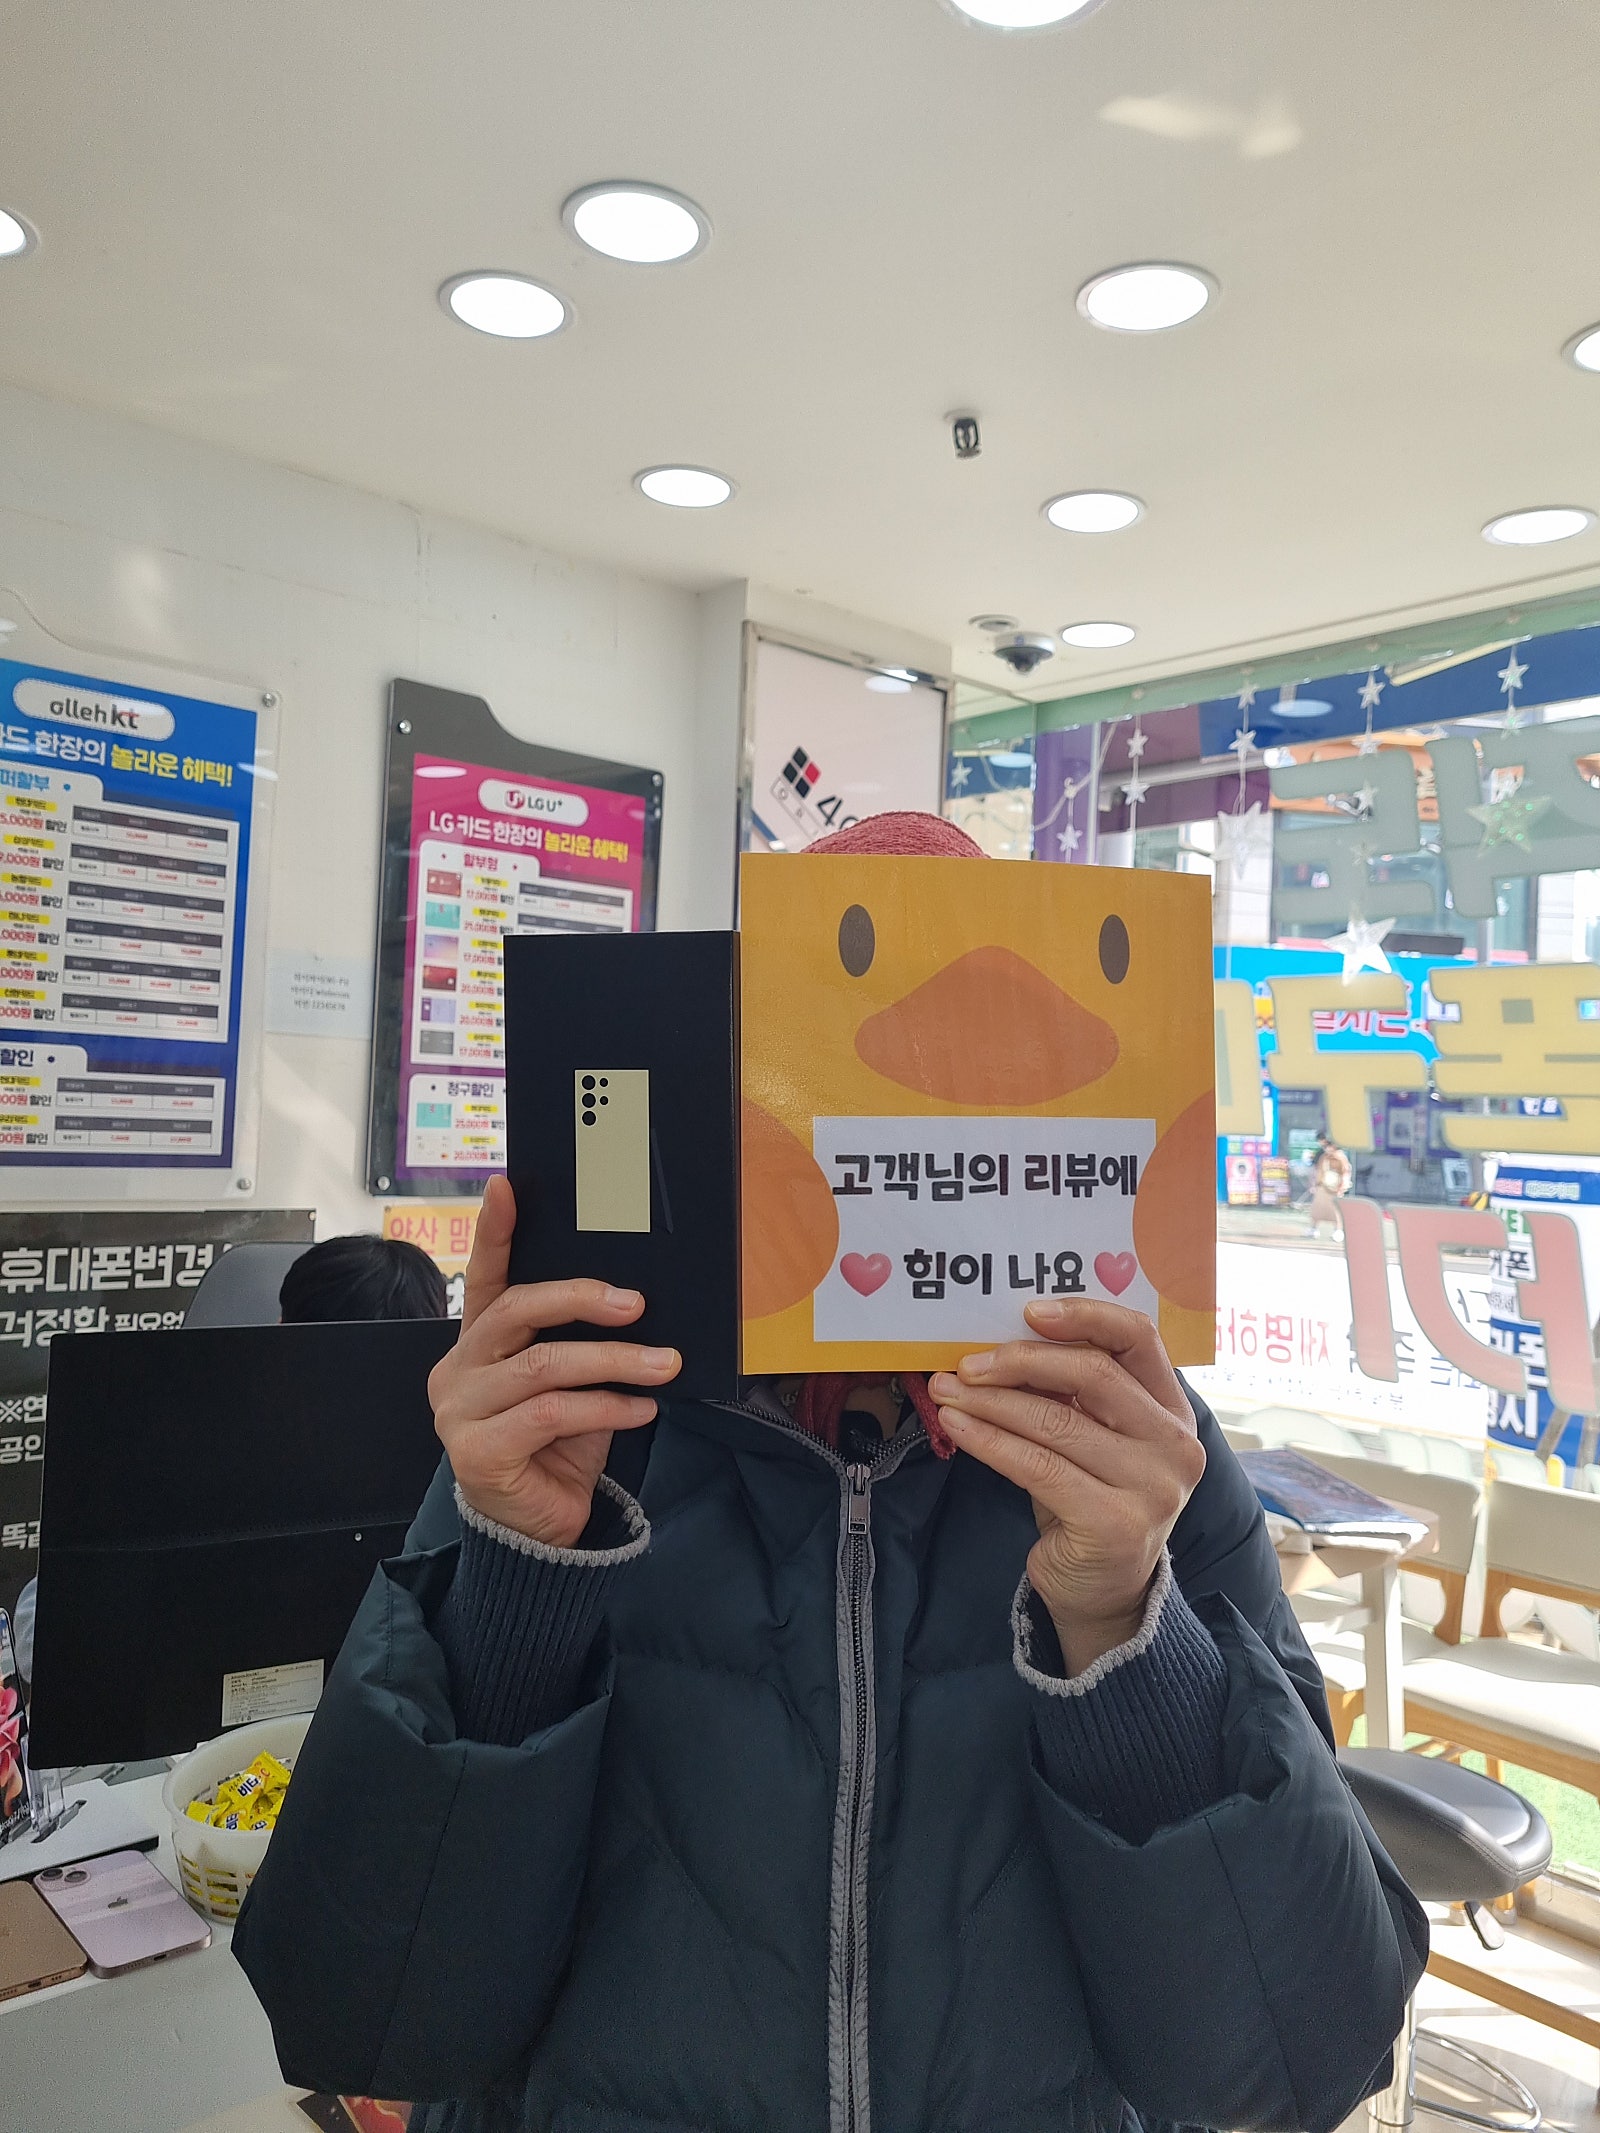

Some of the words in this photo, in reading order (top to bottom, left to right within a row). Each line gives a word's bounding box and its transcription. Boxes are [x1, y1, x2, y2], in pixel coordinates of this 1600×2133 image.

[34, 730, 106, 766] 한장의
[110, 744, 179, 779] 놀라운
[182, 757, 234, 787] 혜택!
[429, 809, 454, 834] LG
[456, 815, 492, 841] 카드
[493, 821, 543, 850] 한장의
[544, 829, 593, 859] 놀라운
[832, 1152, 1009, 1201] 고객님의
[1024, 1153, 1138, 1198] 리뷰에
[0, 1243, 214, 1294] 휴대폰변경
[903, 1248, 993, 1300] 힘이
[1008, 1250, 1087, 1294] 나요
